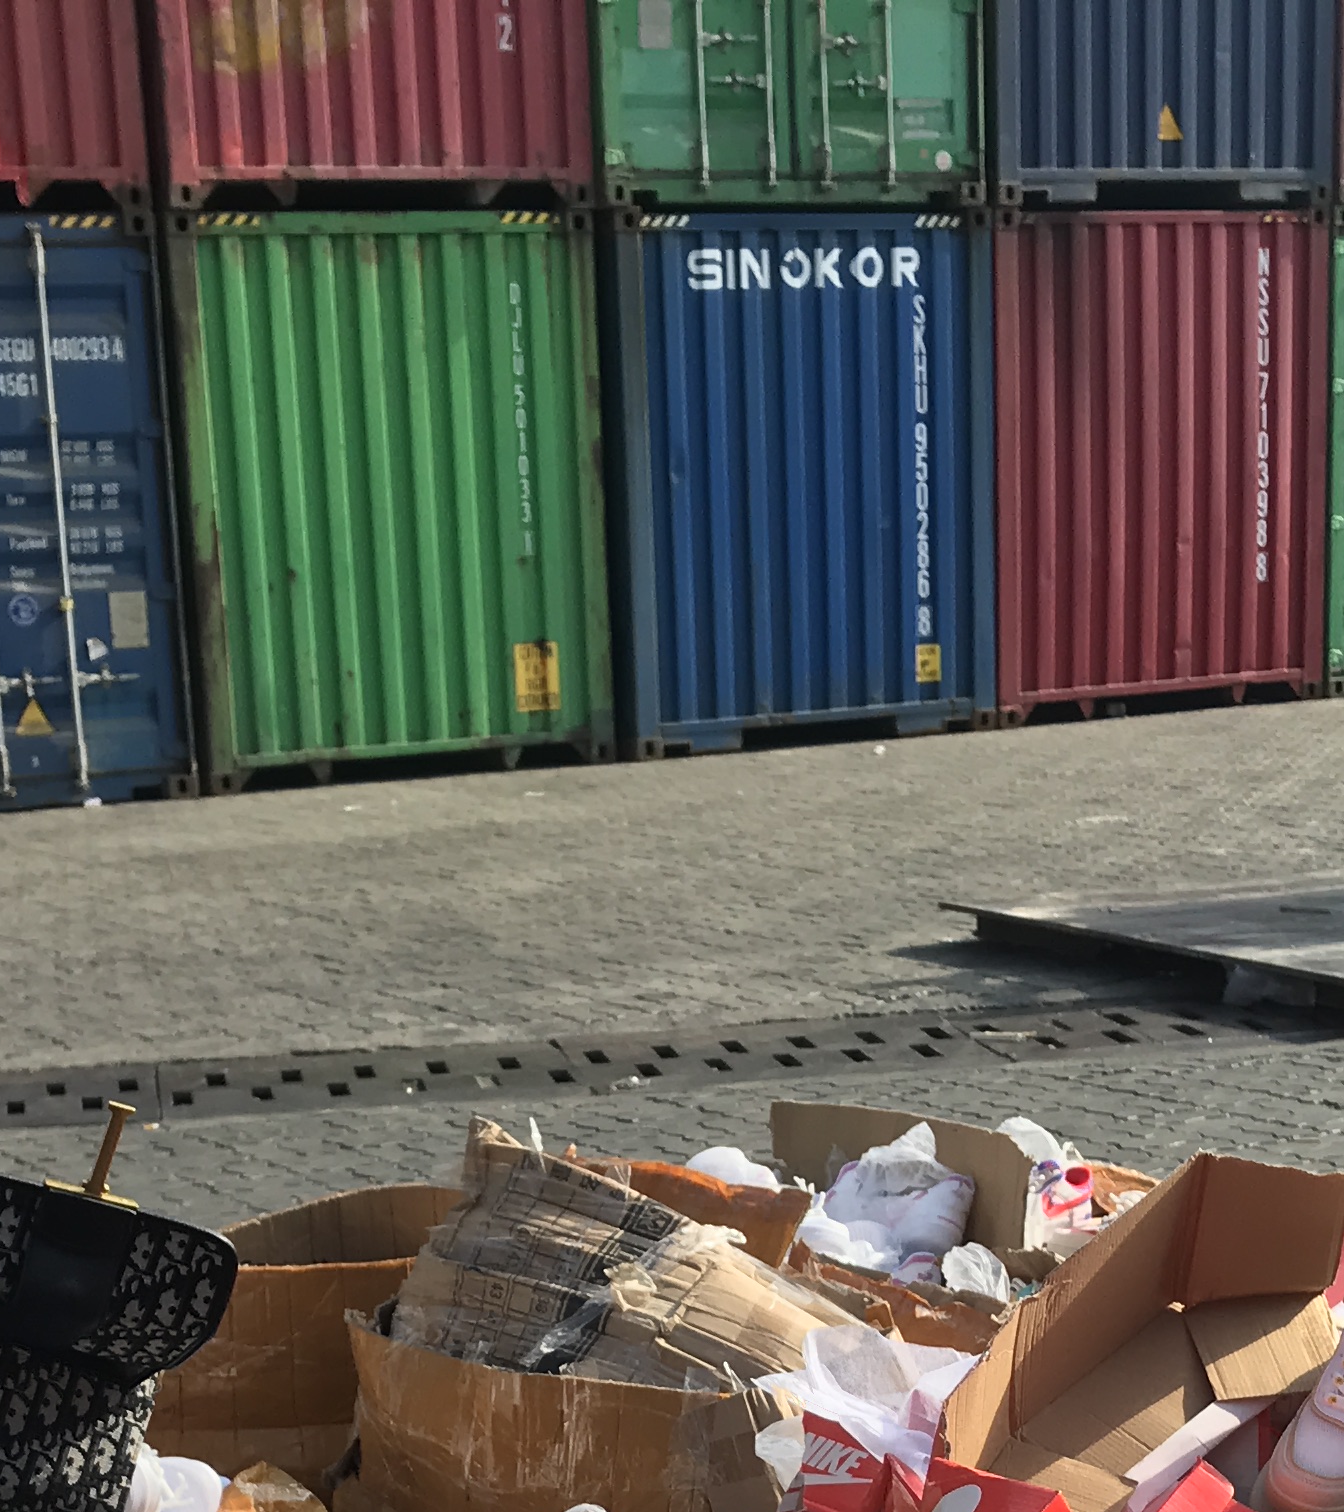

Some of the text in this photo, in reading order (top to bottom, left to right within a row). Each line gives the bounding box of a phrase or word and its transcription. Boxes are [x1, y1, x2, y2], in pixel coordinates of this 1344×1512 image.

[687, 247, 921, 290] SINOKOR
[912, 295, 928, 414] SKHU
[914, 422, 930, 599] 950286
[1256, 371, 1269, 547] 710398
[802, 1431, 869, 1479] NIKE
